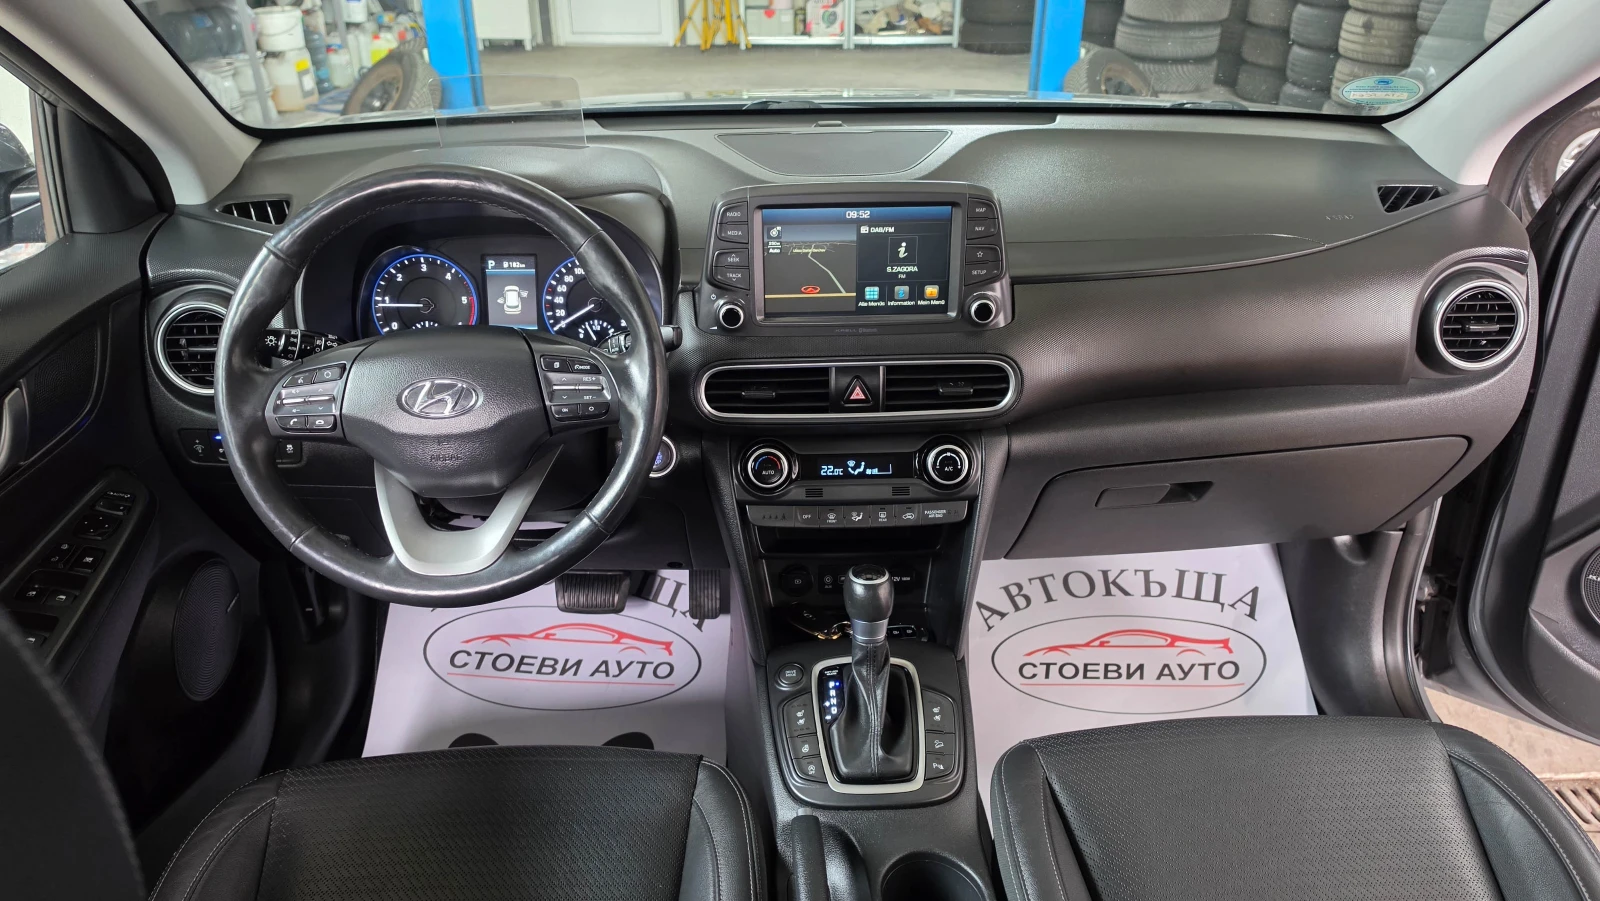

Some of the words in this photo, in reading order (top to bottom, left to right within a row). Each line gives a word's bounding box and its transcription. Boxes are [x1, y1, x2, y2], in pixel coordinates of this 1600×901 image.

[488, 260, 495, 269] P
[976, 568, 1260, 632] АВТОКЪЩА
[449, 650, 583, 676] СТОЕВИ
[590, 660, 675, 680] АУТО
[1018, 662, 1145, 680] СТОЕВИ
[1156, 660, 1240, 680] АУТО
